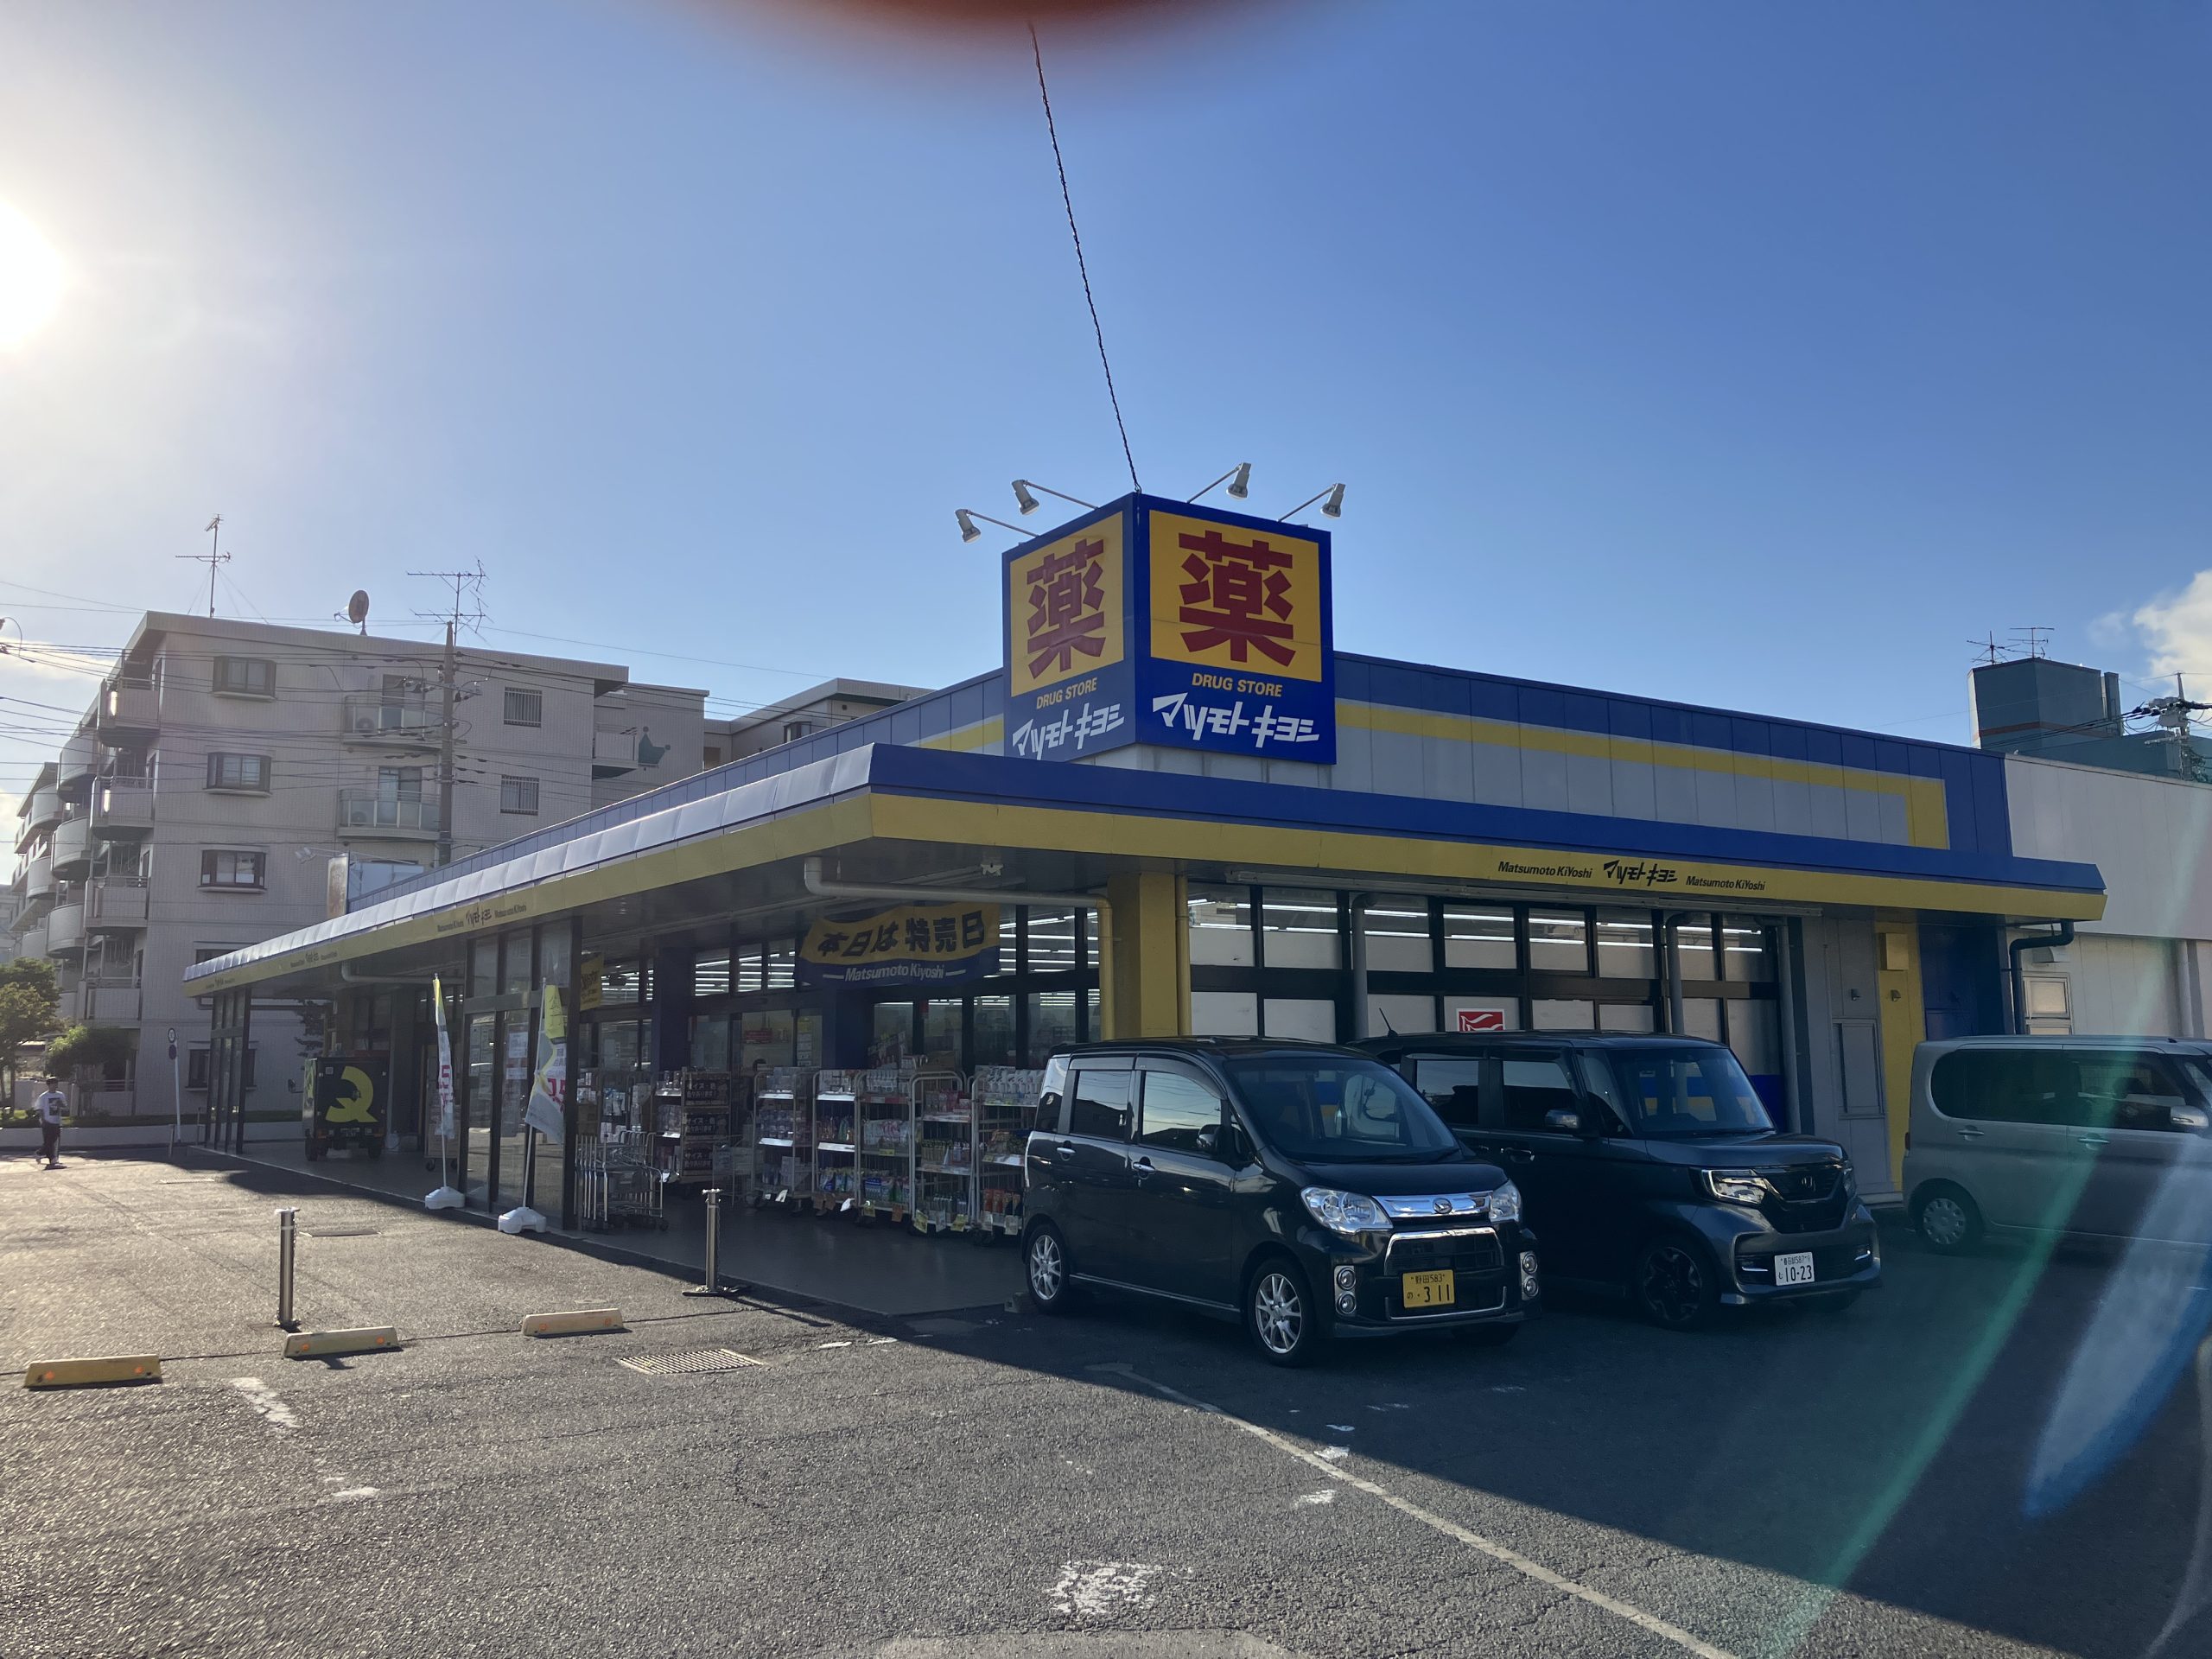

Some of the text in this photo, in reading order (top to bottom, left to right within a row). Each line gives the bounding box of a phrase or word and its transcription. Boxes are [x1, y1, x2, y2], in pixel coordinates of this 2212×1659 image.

[1027, 538, 1106, 679] 薬
[1179, 530, 1296, 667] 薬
[1036, 677, 1097, 709] DRUG STORE
[1192, 673, 1283, 697] DRUG STORE
[1012, 702, 1125, 760] マツモトキヨシ
[1153, 692, 1319, 748] マツモトキヨシ
[1497, 861, 1593, 879] Matsumoto KiYoshi
[1603, 859, 1678, 887] マツモトキヨシ
[1686, 875, 1766, 891] Matsumoto KiYoshi
[817, 910, 985, 957] 本日は特売日
[844, 963, 944, 982] Matsumoto Kiyoshi
[1415, 1273, 1443, 1285] 野田583
